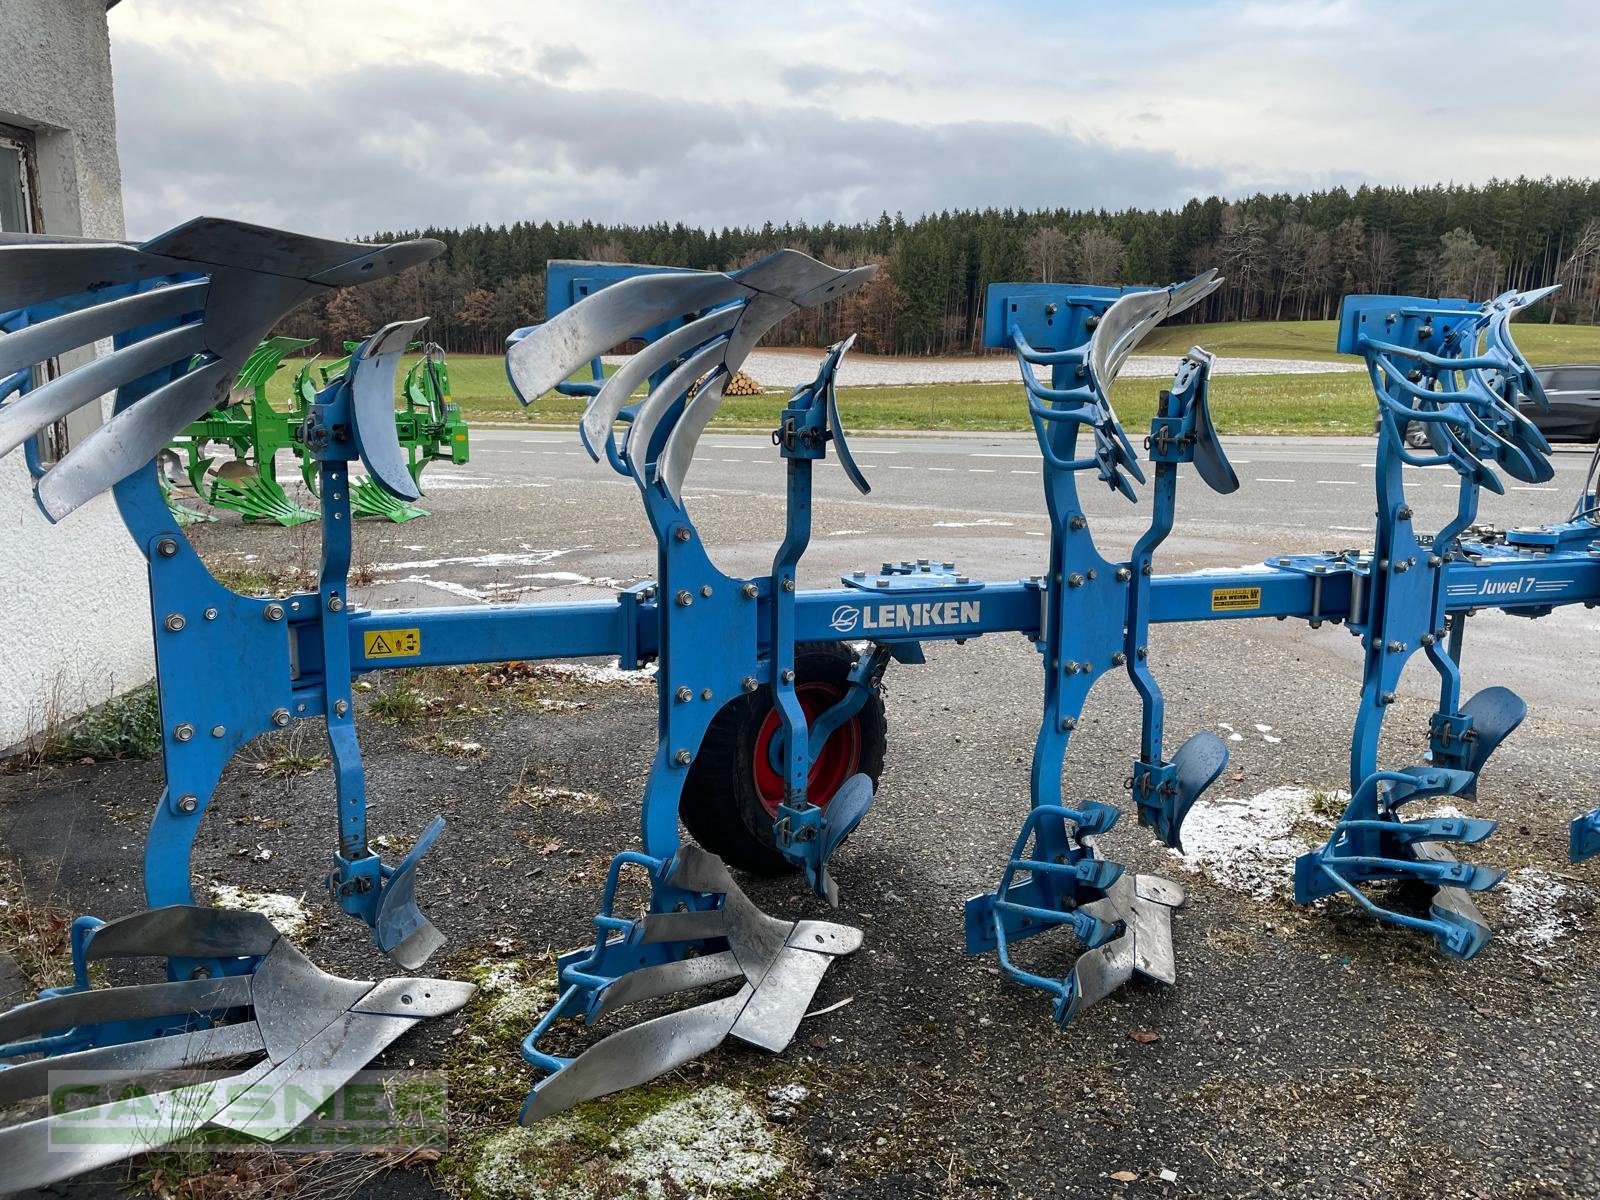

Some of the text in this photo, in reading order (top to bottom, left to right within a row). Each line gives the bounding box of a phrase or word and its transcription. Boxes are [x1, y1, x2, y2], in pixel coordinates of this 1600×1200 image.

[1478, 577, 1536, 595] Juwel 7
[863, 601, 981, 632] LEMKEN
